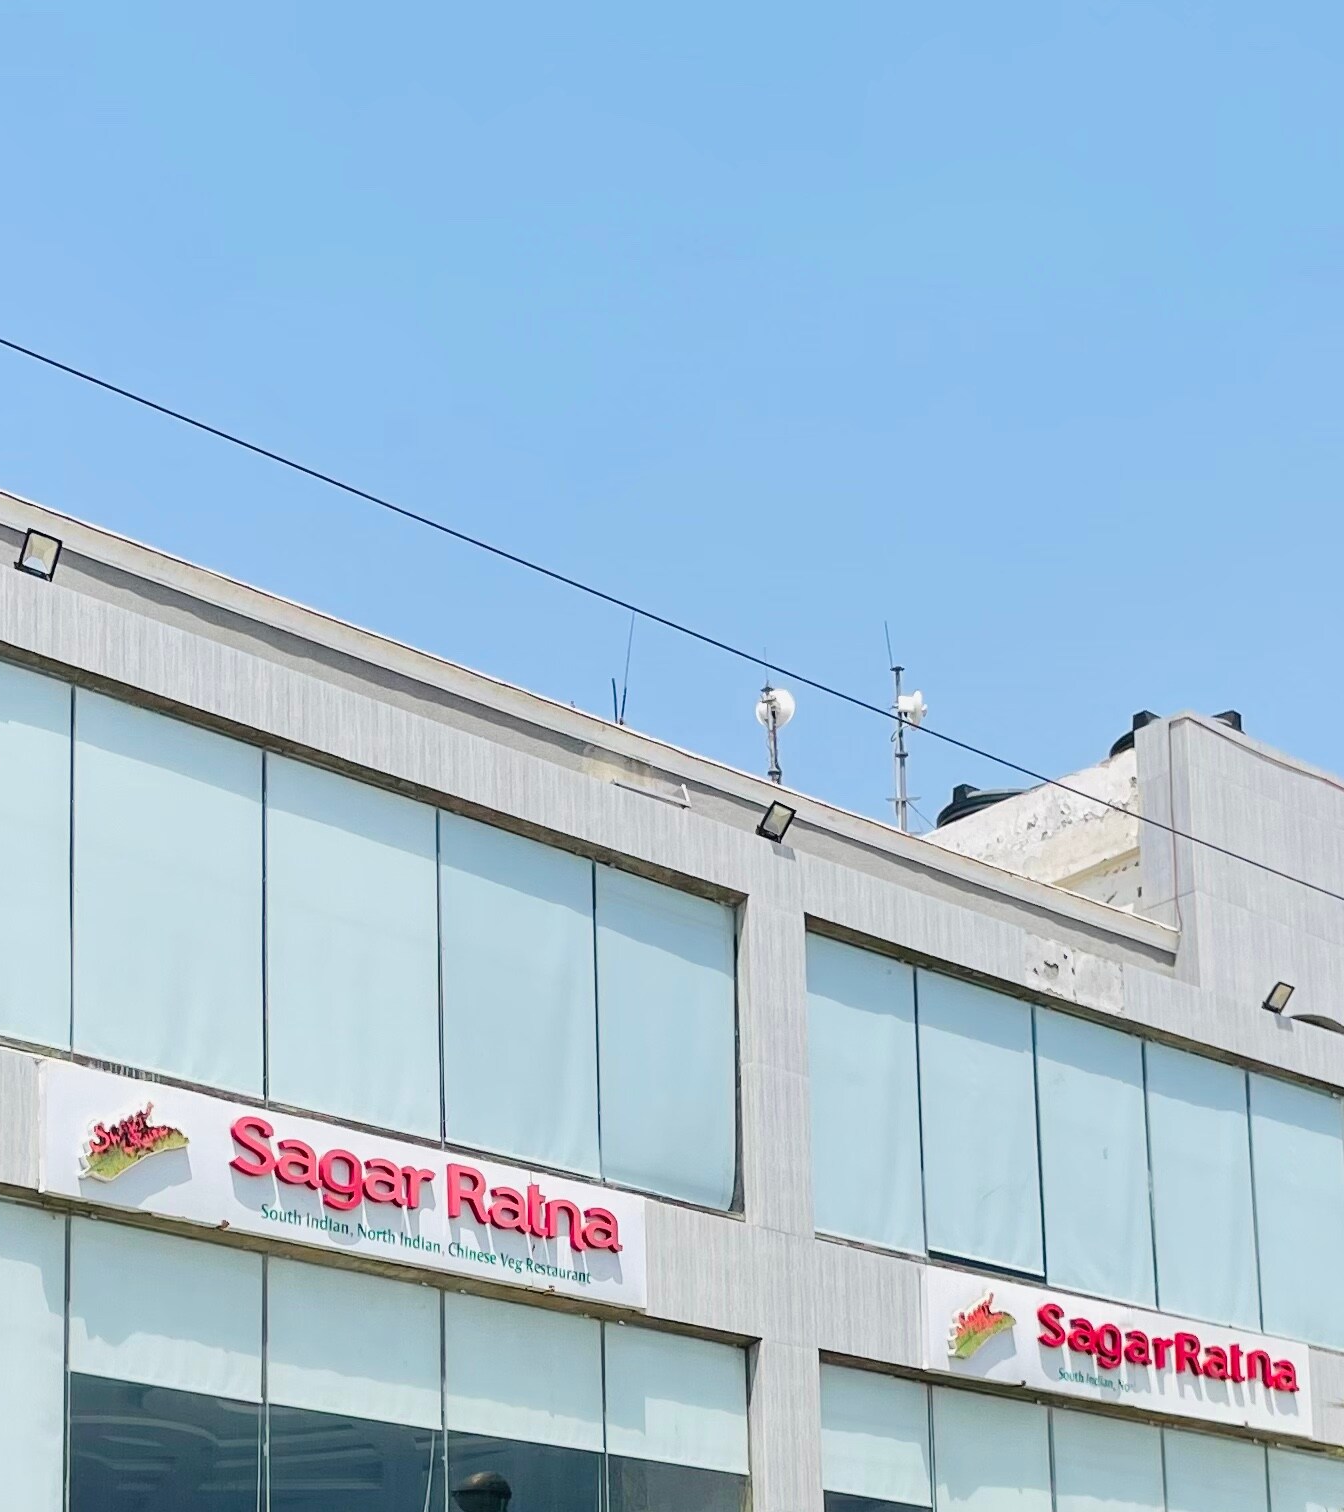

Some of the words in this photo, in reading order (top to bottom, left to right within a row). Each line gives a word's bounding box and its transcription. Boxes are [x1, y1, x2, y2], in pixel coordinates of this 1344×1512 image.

[229, 1116, 436, 1212] Sagar
[446, 1162, 624, 1253] Ratna
[260, 1203, 302, 1227] South
[306, 1213, 354, 1238] Indian,
[357, 1222, 397, 1245] North
[448, 1241, 497, 1265] Chinese
[500, 1252, 524, 1274] Veg
[525, 1257, 592, 1285] Restaurant
[1058, 1367, 1084, 1384] South
